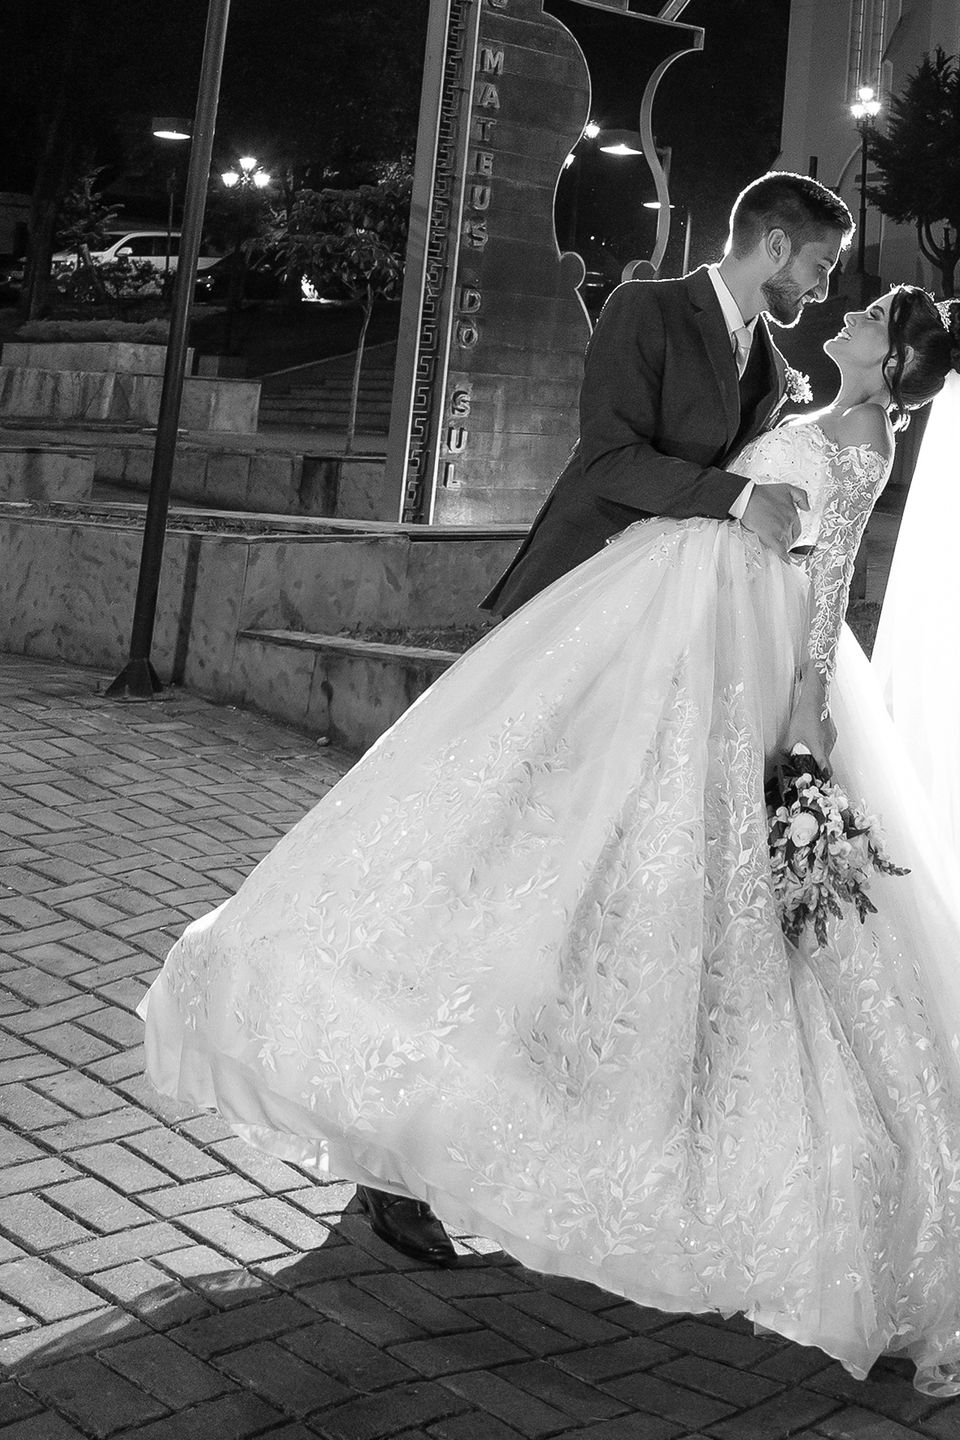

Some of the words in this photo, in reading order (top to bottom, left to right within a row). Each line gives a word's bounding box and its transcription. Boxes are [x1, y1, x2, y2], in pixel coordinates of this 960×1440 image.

[471, 47, 505, 249] MATEUS
[458, 287, 481, 349] DO
[444, 390, 471, 490] SUL
